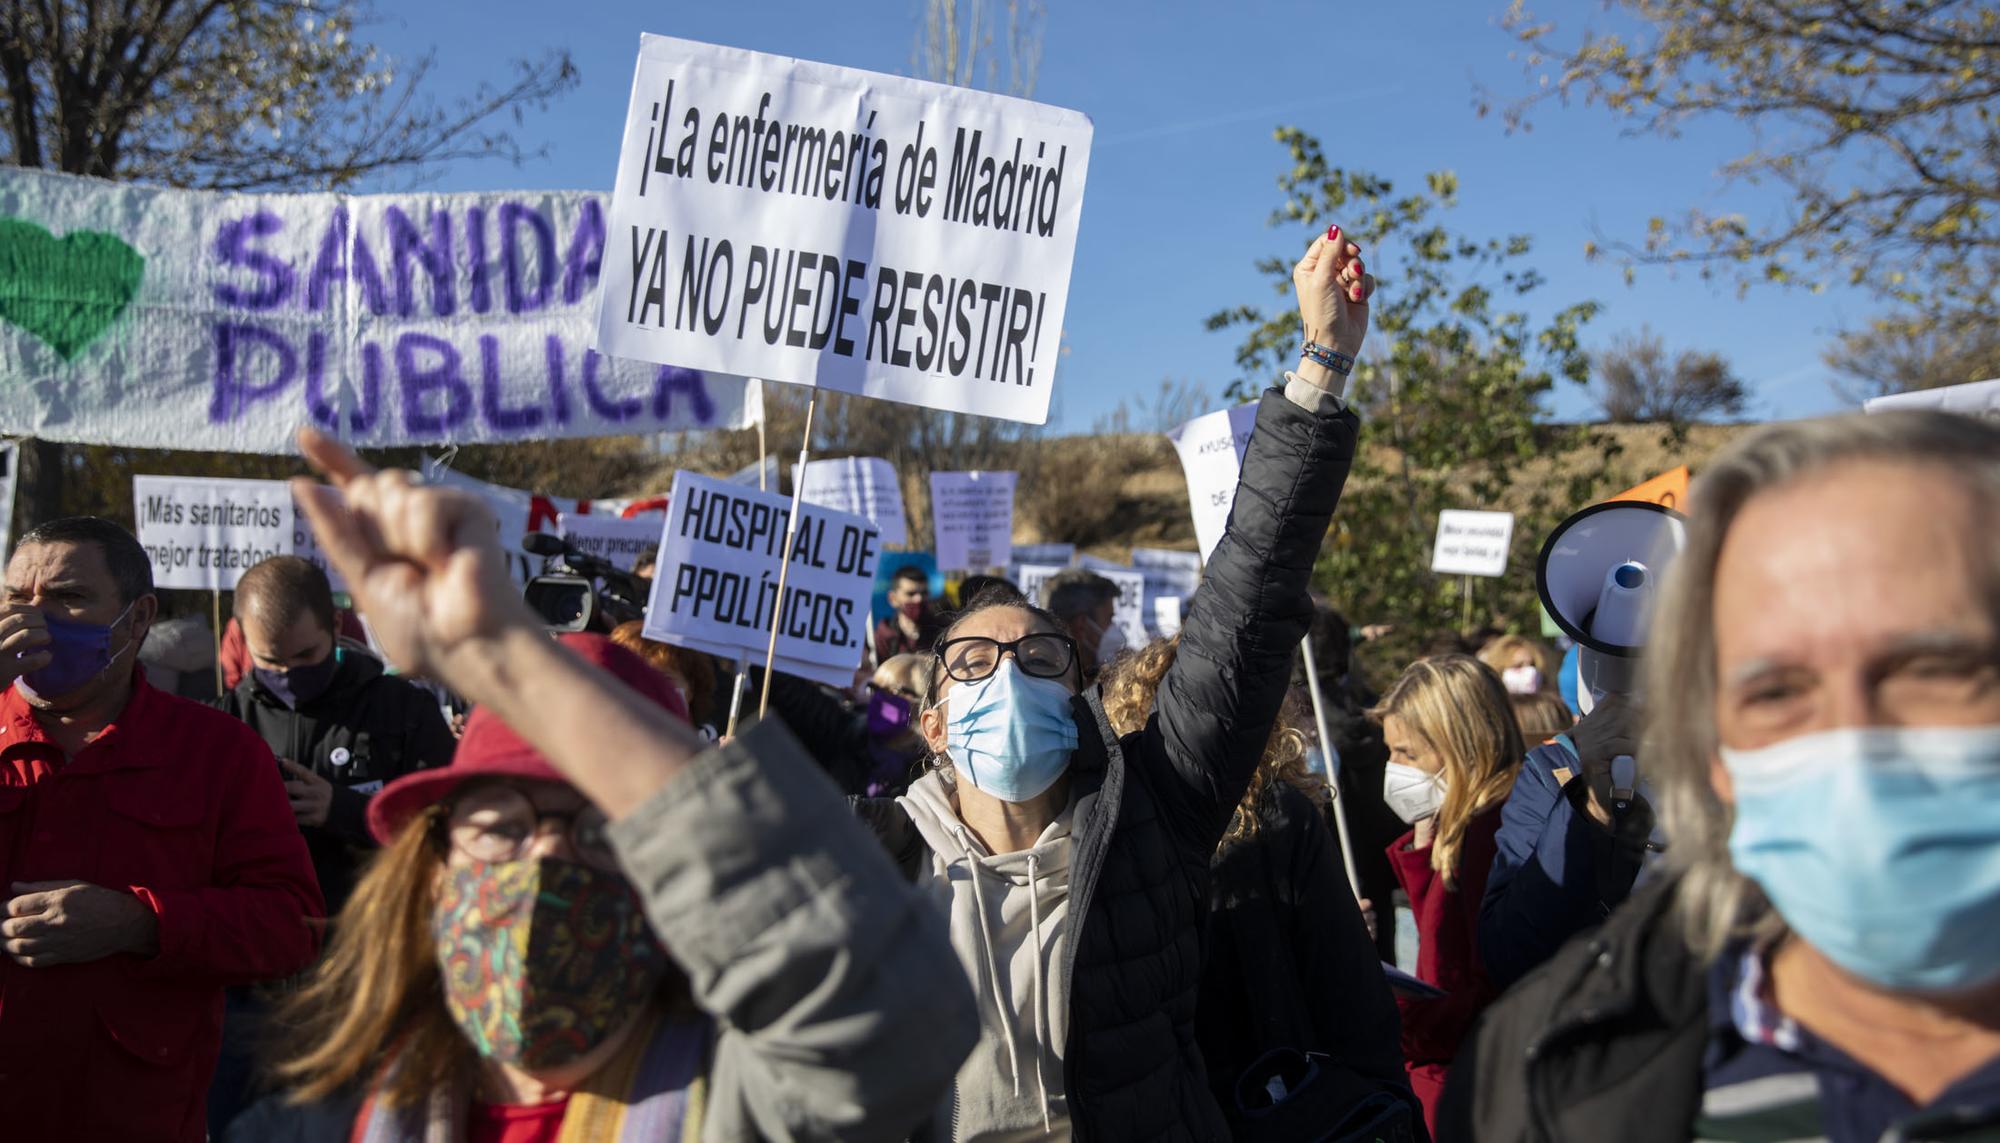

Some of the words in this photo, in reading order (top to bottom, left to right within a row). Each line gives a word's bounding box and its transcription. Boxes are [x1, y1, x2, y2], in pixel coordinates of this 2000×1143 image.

[639, 79, 700, 197] ¡La
[707, 92, 888, 210] enfermería
[899, 120, 938, 219] de
[942, 127, 1068, 238] Madrid
[212, 196, 606, 318] SANIDA
[627, 225, 669, 328] YA
[675, 234, 734, 337] NO
[736, 245, 869, 358] PUEDE
[865, 265, 1047, 387] RESISTIR!
[208, 322, 716, 436] PUBLICA
[140, 495, 183, 530] ¡Más
[190, 498, 281, 528] sanitarios
[144, 540, 194, 574] mejor
[680, 486, 826, 569] HOSPITAL
[836, 524, 879, 578] DE
[670, 562, 857, 648] PPOLÍTICOS.
